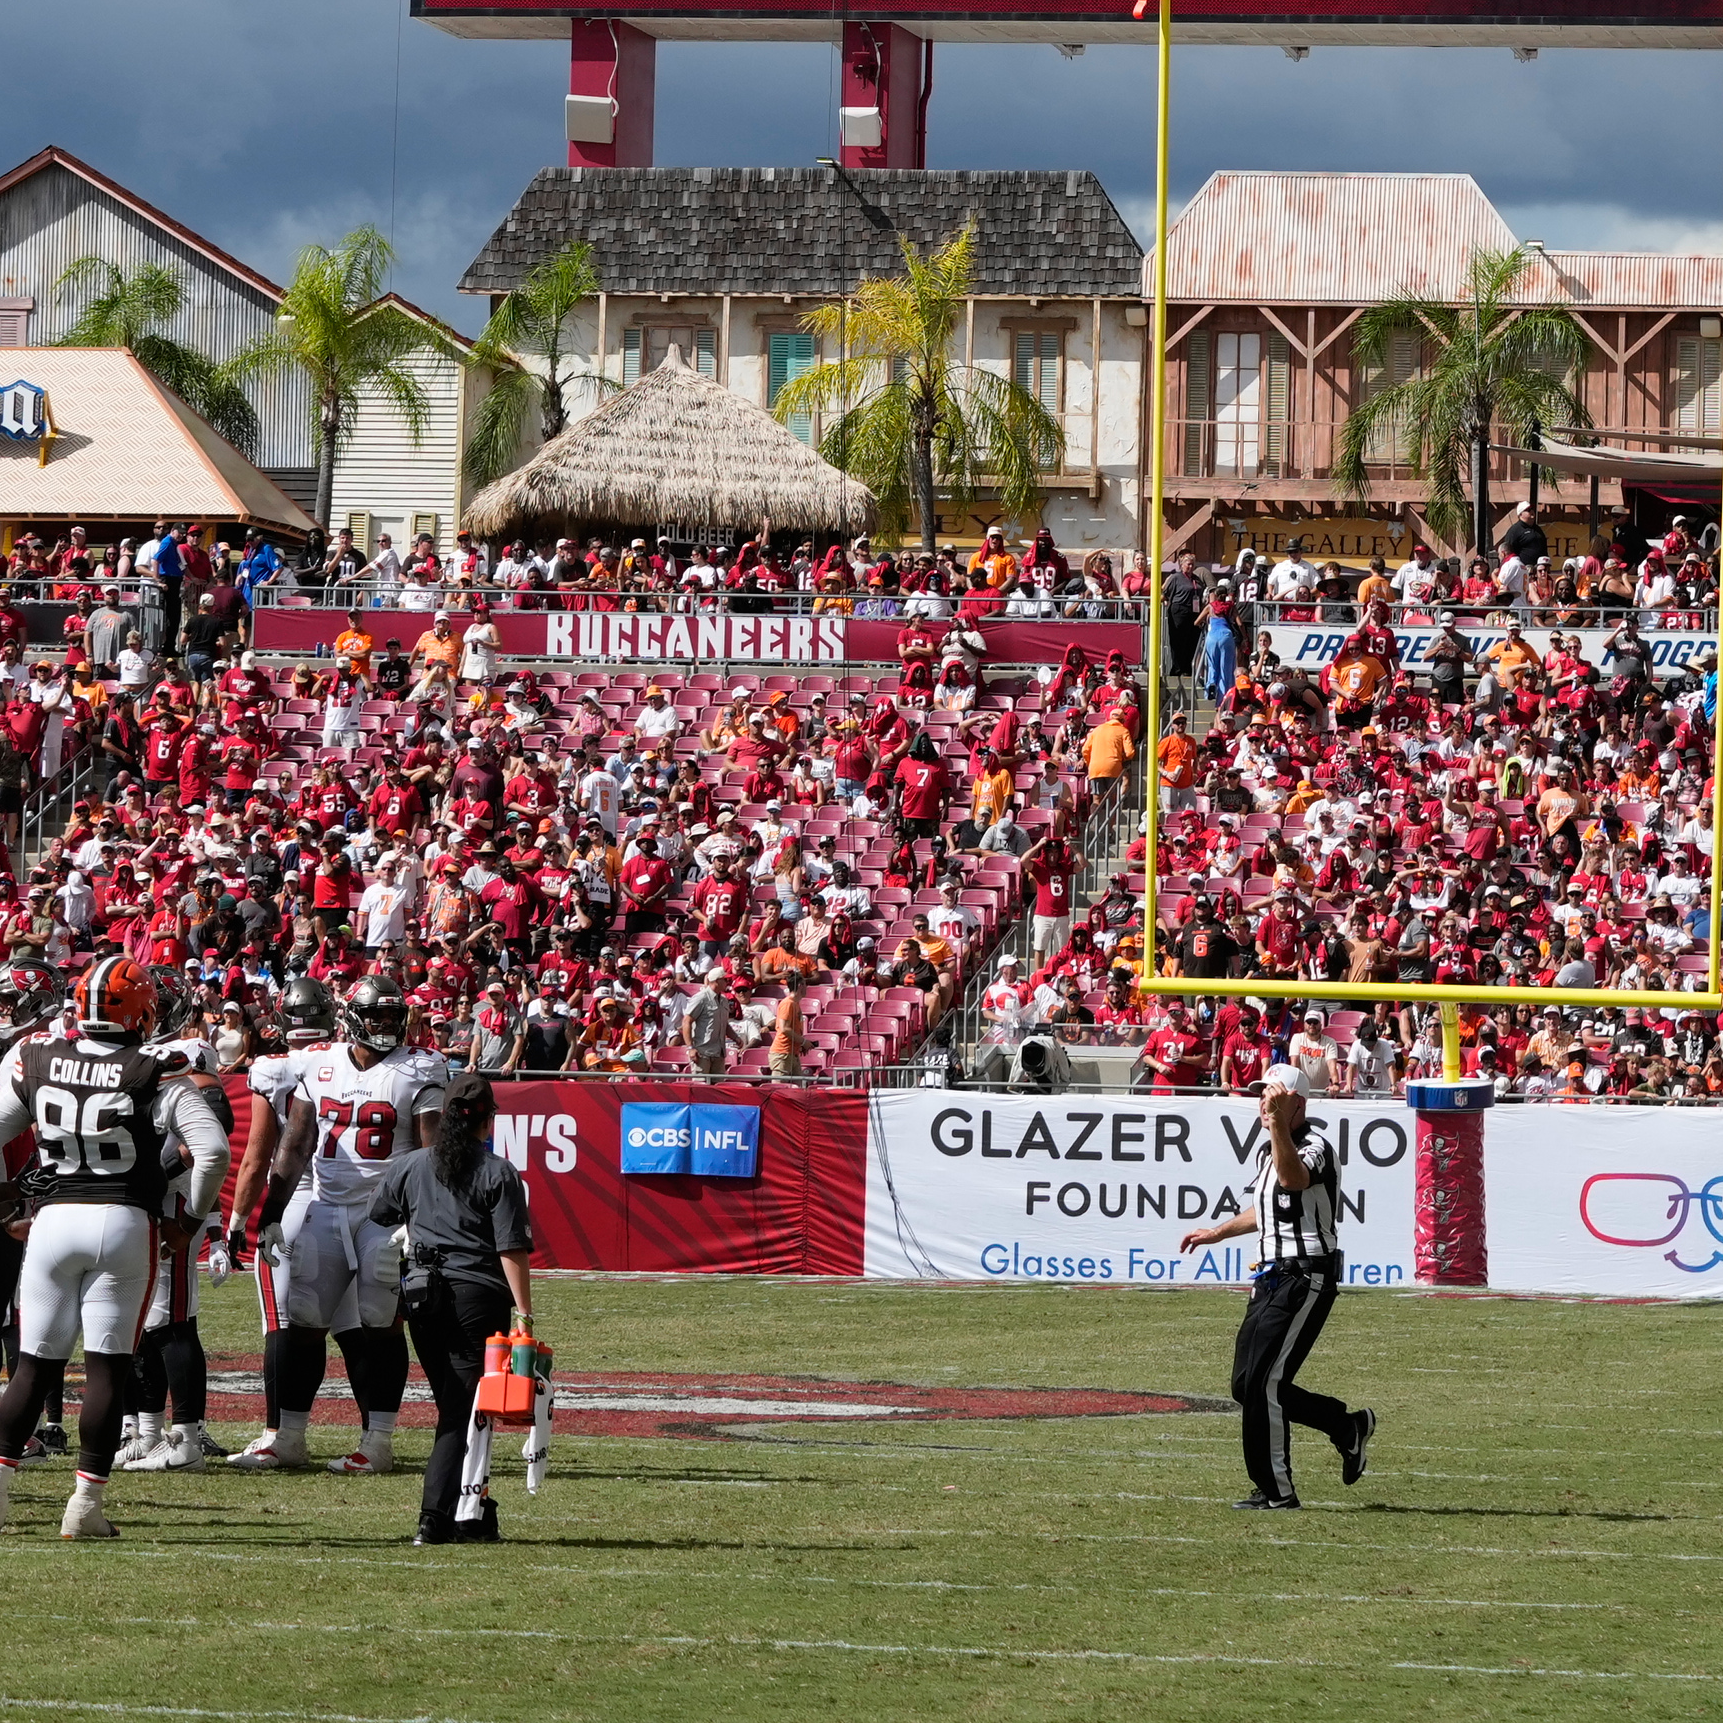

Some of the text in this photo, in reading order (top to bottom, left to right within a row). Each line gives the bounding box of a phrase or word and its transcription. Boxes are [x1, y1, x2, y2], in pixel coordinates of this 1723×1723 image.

[698, 526, 736, 547] BEER
[1231, 530, 1406, 560] THE GALLEY
[1031, 567, 1056, 589] 99
[1238, 584, 1257, 601] 12
[546, 614, 845, 661] BUCCANEERS
[1368, 637, 1386, 654] 13
[1349, 667, 1362, 687] 6
[1389, 717, 1409, 731] 12
[157, 741, 169, 759] 6
[915, 769, 928, 786] 7
[324, 793, 346, 812] 55
[527, 790, 538, 808] 3
[600, 791, 610, 811] 6
[1050, 876, 1063, 896] 6
[706, 894, 730, 915] 82
[1193, 934, 1208, 956] 6
[82, 1021, 110, 1031] CLEVELAND
[48, 1056, 124, 1090] COLLINS
[340, 1089, 373, 1100] BUCCANEERS
[318, 1096, 397, 1161] 78
[930, 1107, 1193, 1163] GLAZER
[646, 1128, 749, 1151] CBS NFL
[980, 1242, 1241, 1281] Glasses For All
